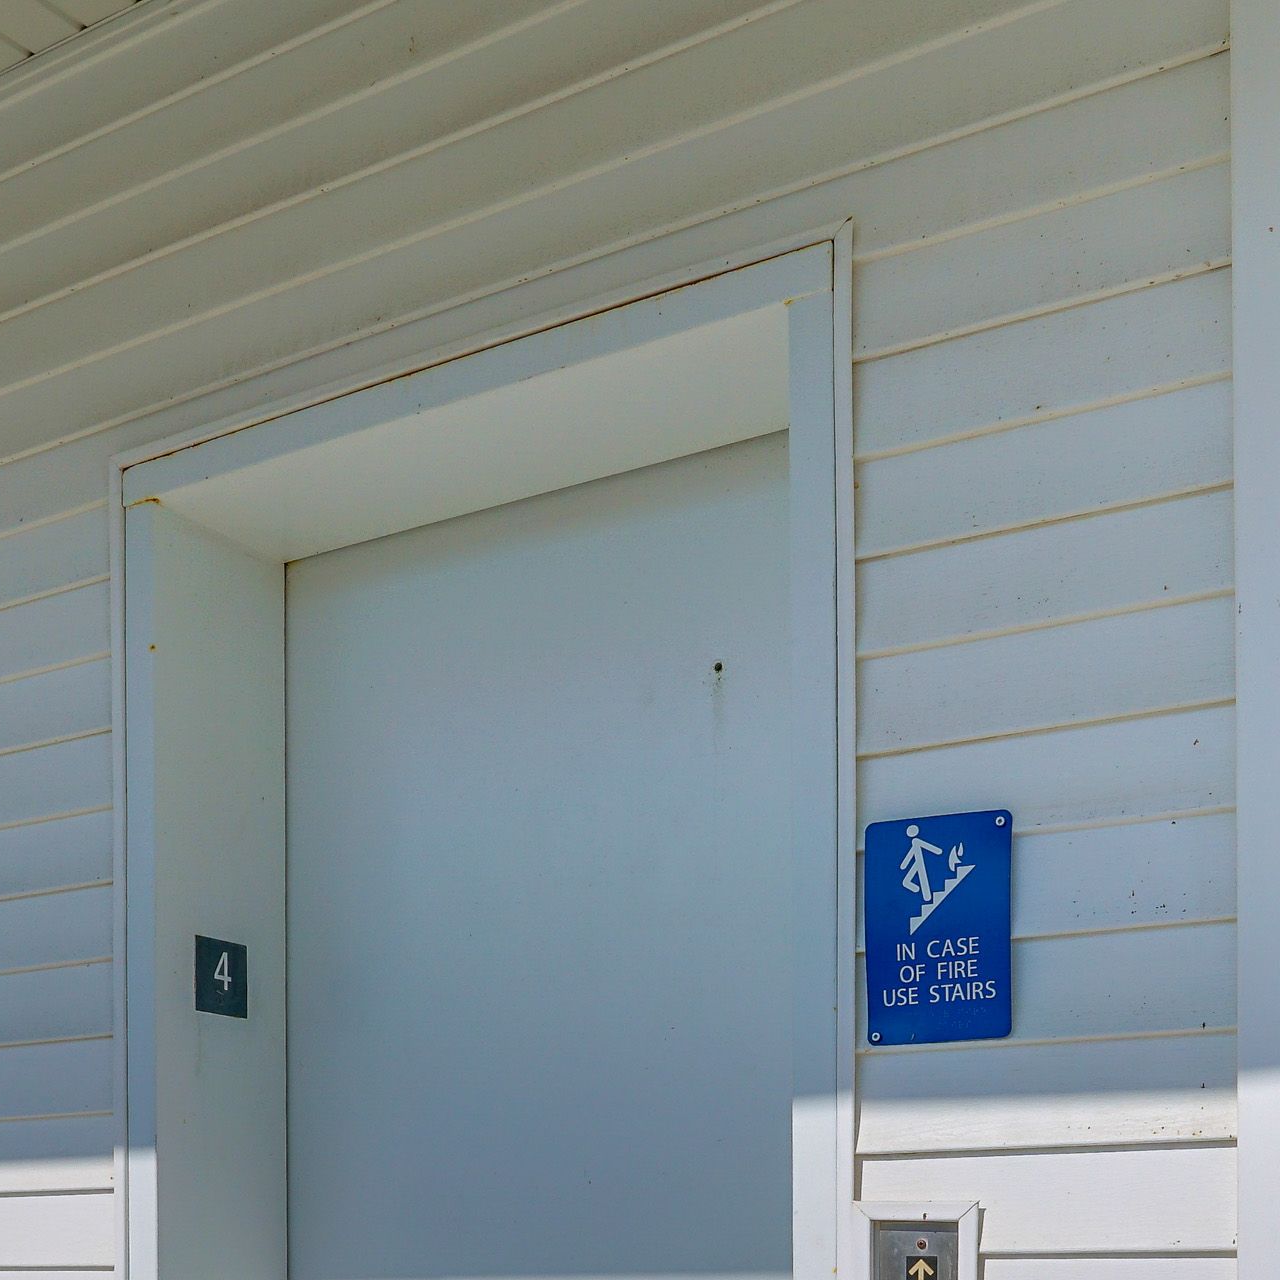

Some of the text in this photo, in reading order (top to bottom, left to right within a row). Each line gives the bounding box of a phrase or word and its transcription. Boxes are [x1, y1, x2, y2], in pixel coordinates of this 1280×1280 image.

[896, 936, 980, 962] IN CASE
[214, 951, 232, 991] 4
[899, 959, 978, 984] OF FIRE
[883, 980, 997, 1007] USE STAIRS
